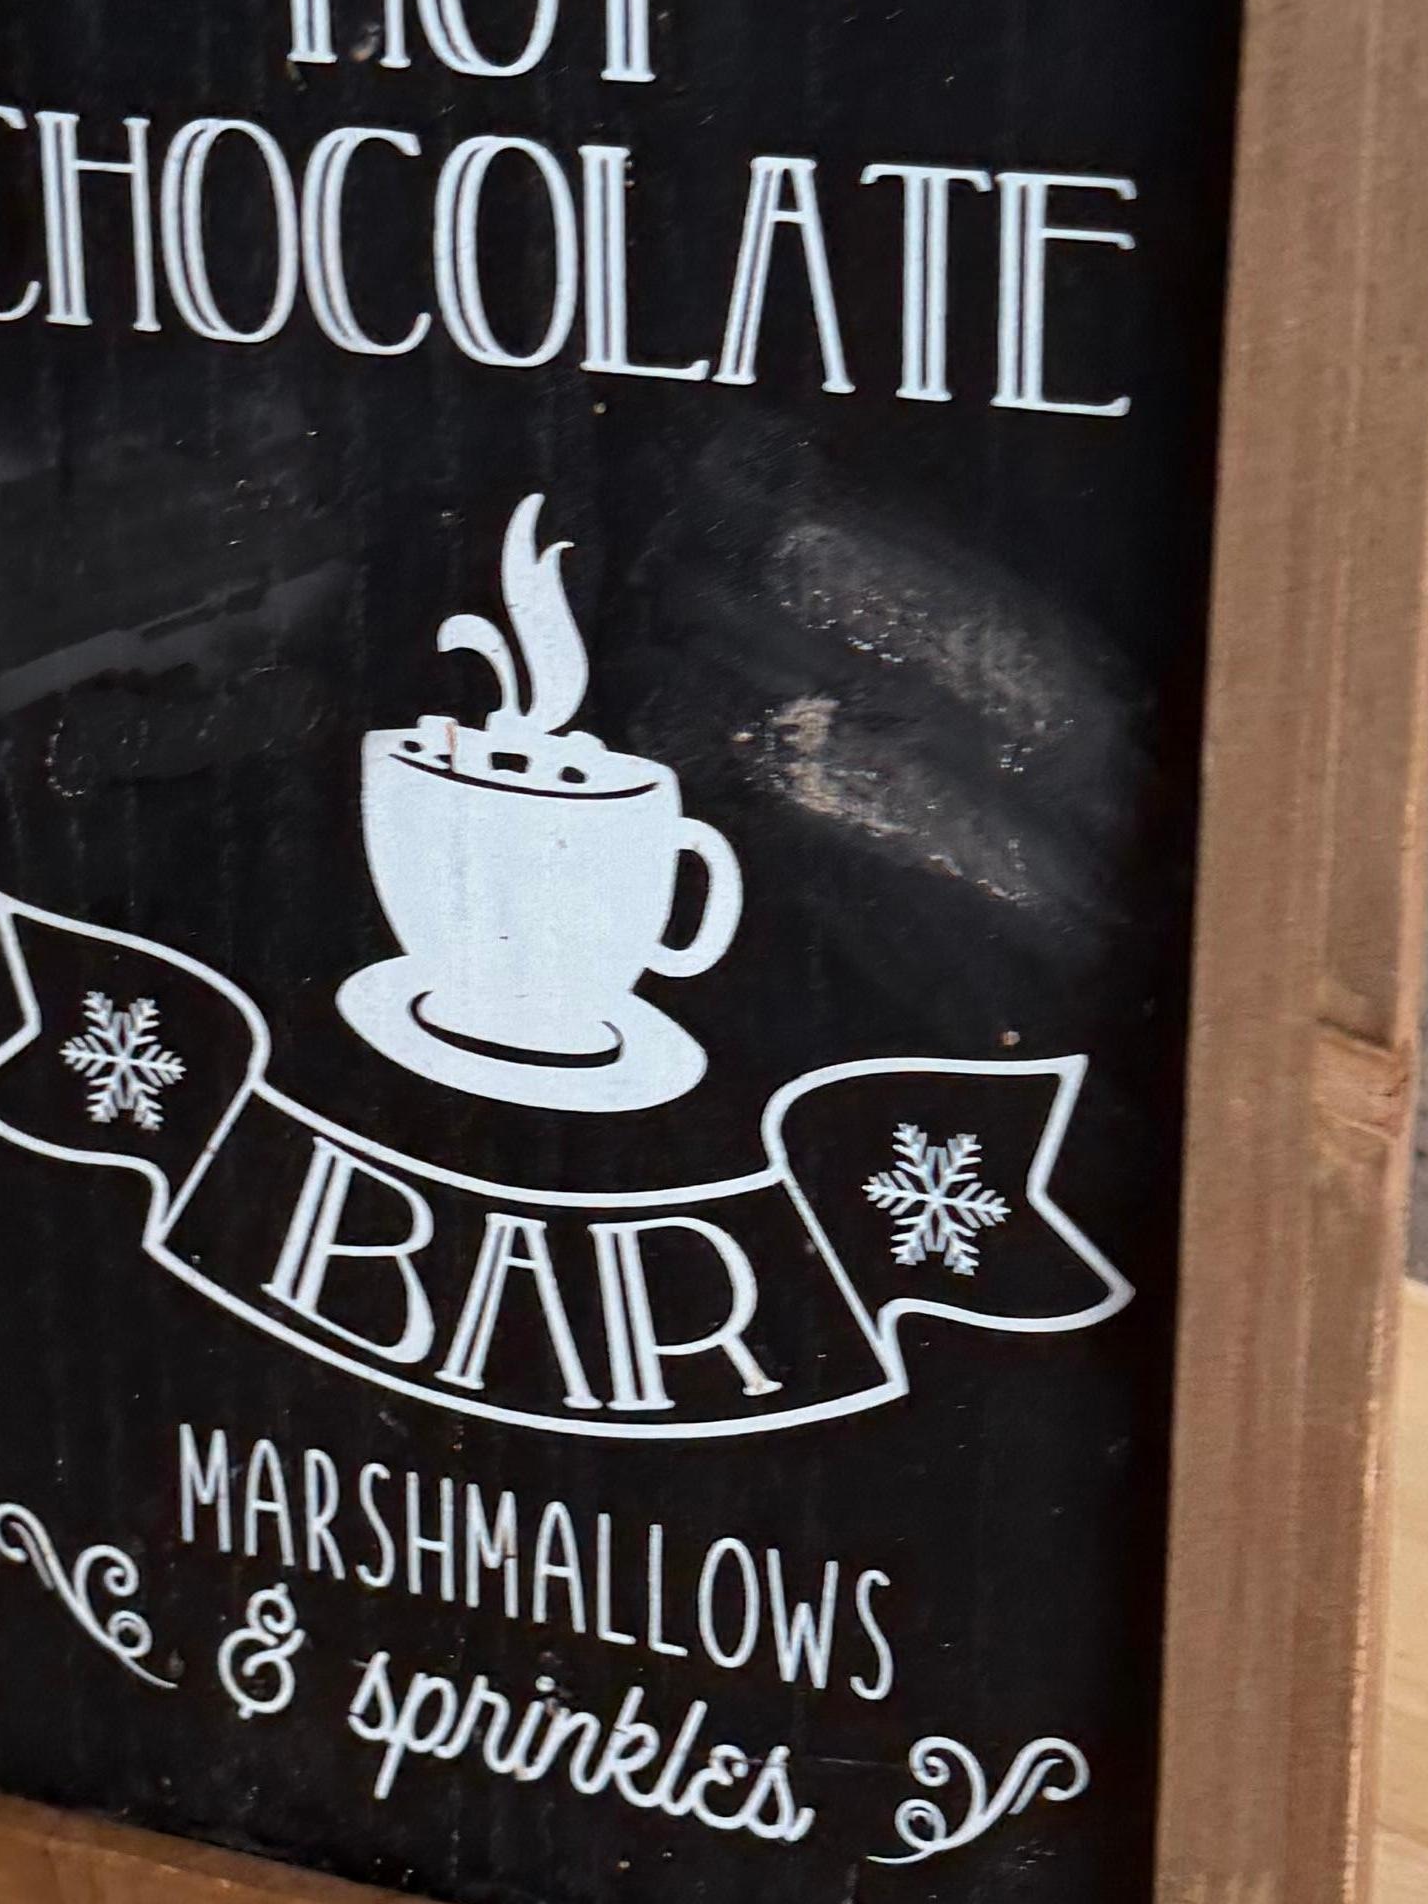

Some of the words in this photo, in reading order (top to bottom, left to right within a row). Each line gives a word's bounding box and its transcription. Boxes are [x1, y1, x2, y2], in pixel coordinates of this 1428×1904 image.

[259, 1134, 785, 1413] BAR
[177, 1421, 895, 1702] MARSHMALLOWS
[215, 1581, 307, 1721] &
[346, 1650, 817, 1844] sprinkles
